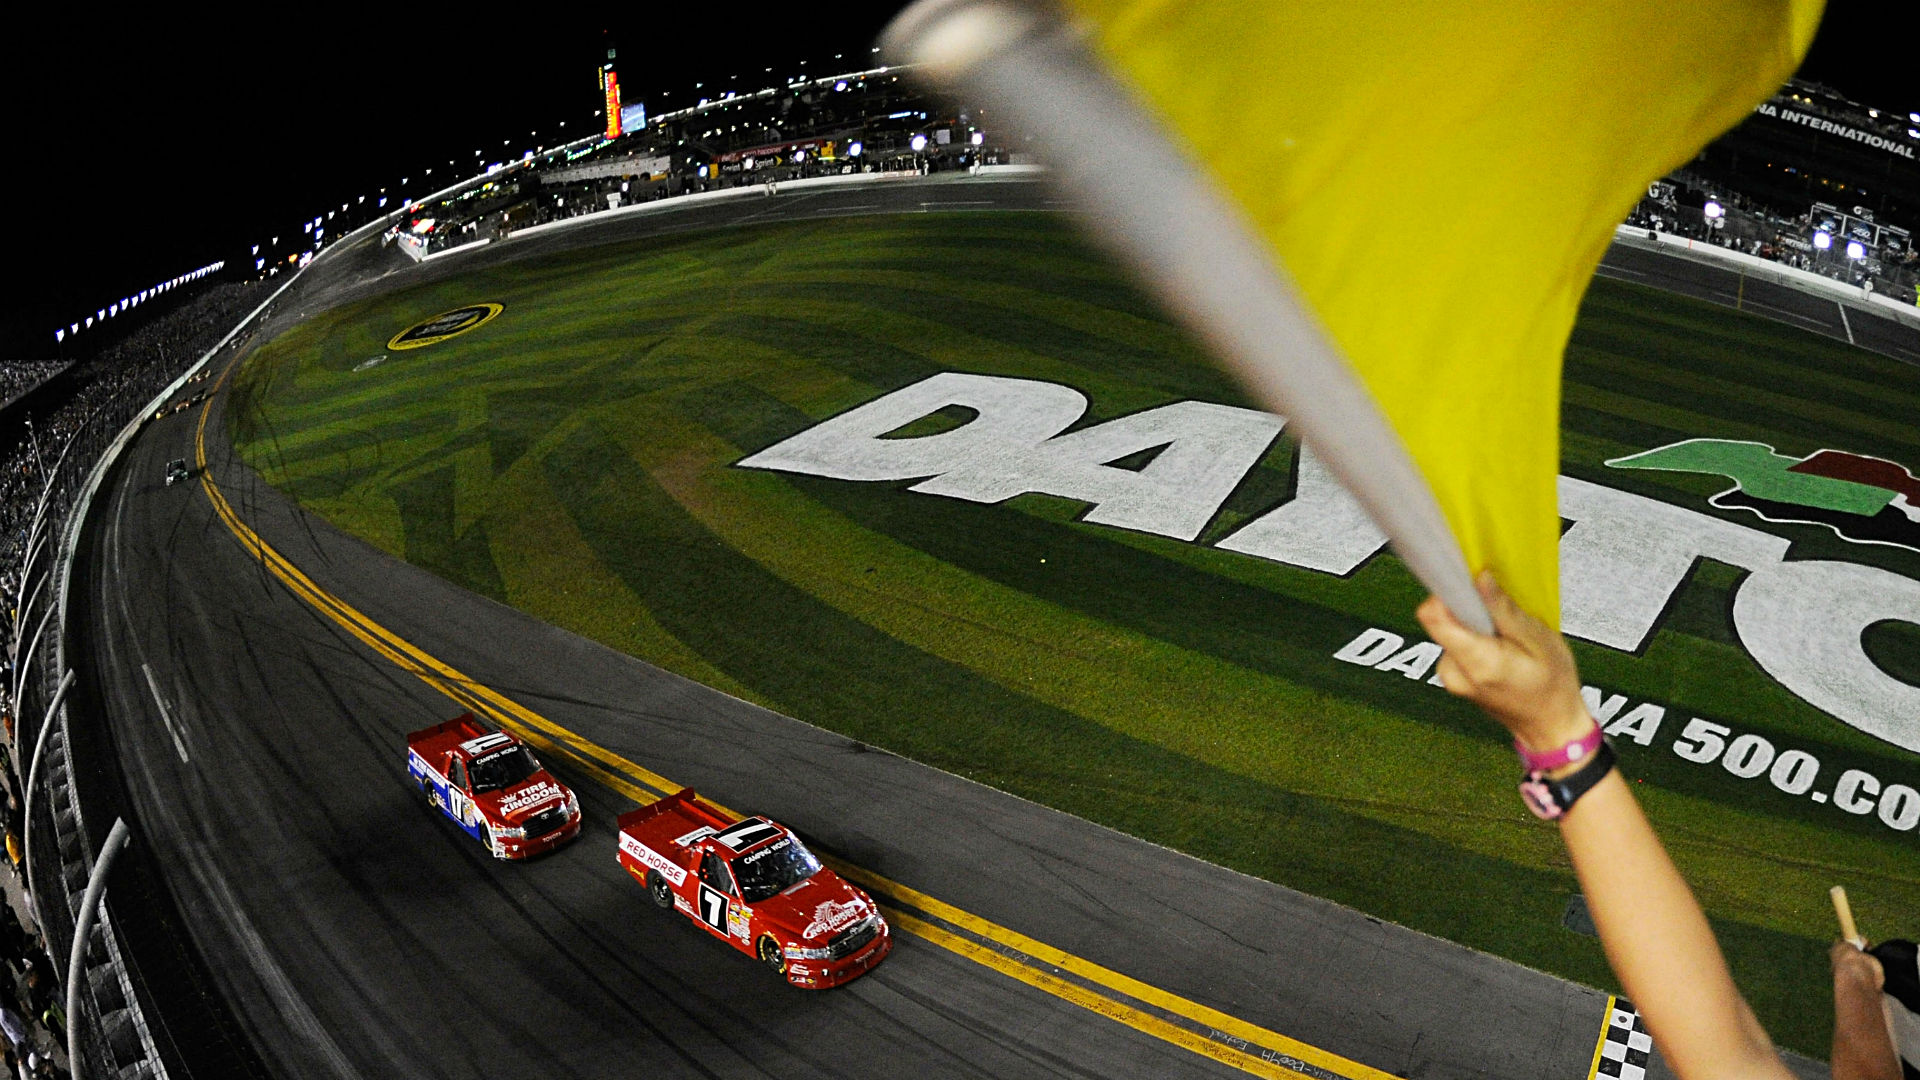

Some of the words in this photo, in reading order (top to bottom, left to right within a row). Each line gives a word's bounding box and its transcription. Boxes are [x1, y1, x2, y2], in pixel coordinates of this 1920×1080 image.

[1781, 109, 1915, 159] INTERNATIONAL
[755, 158, 774, 168] Sprint
[1333, 628, 1666, 747] DANA
[476, 753, 500, 765] CAMPING
[500, 746, 517, 755] WORLD
[449, 787, 462, 819] 17
[500, 786, 560, 816] KINGDOM
[518, 781, 547, 797] TIRE
[626, 841, 646, 857] RED
[647, 854, 682, 880] HORSE
[744, 848, 771, 864] CAMPING
[771, 839, 790, 851] WORLD
[704, 890, 722, 927] 7
